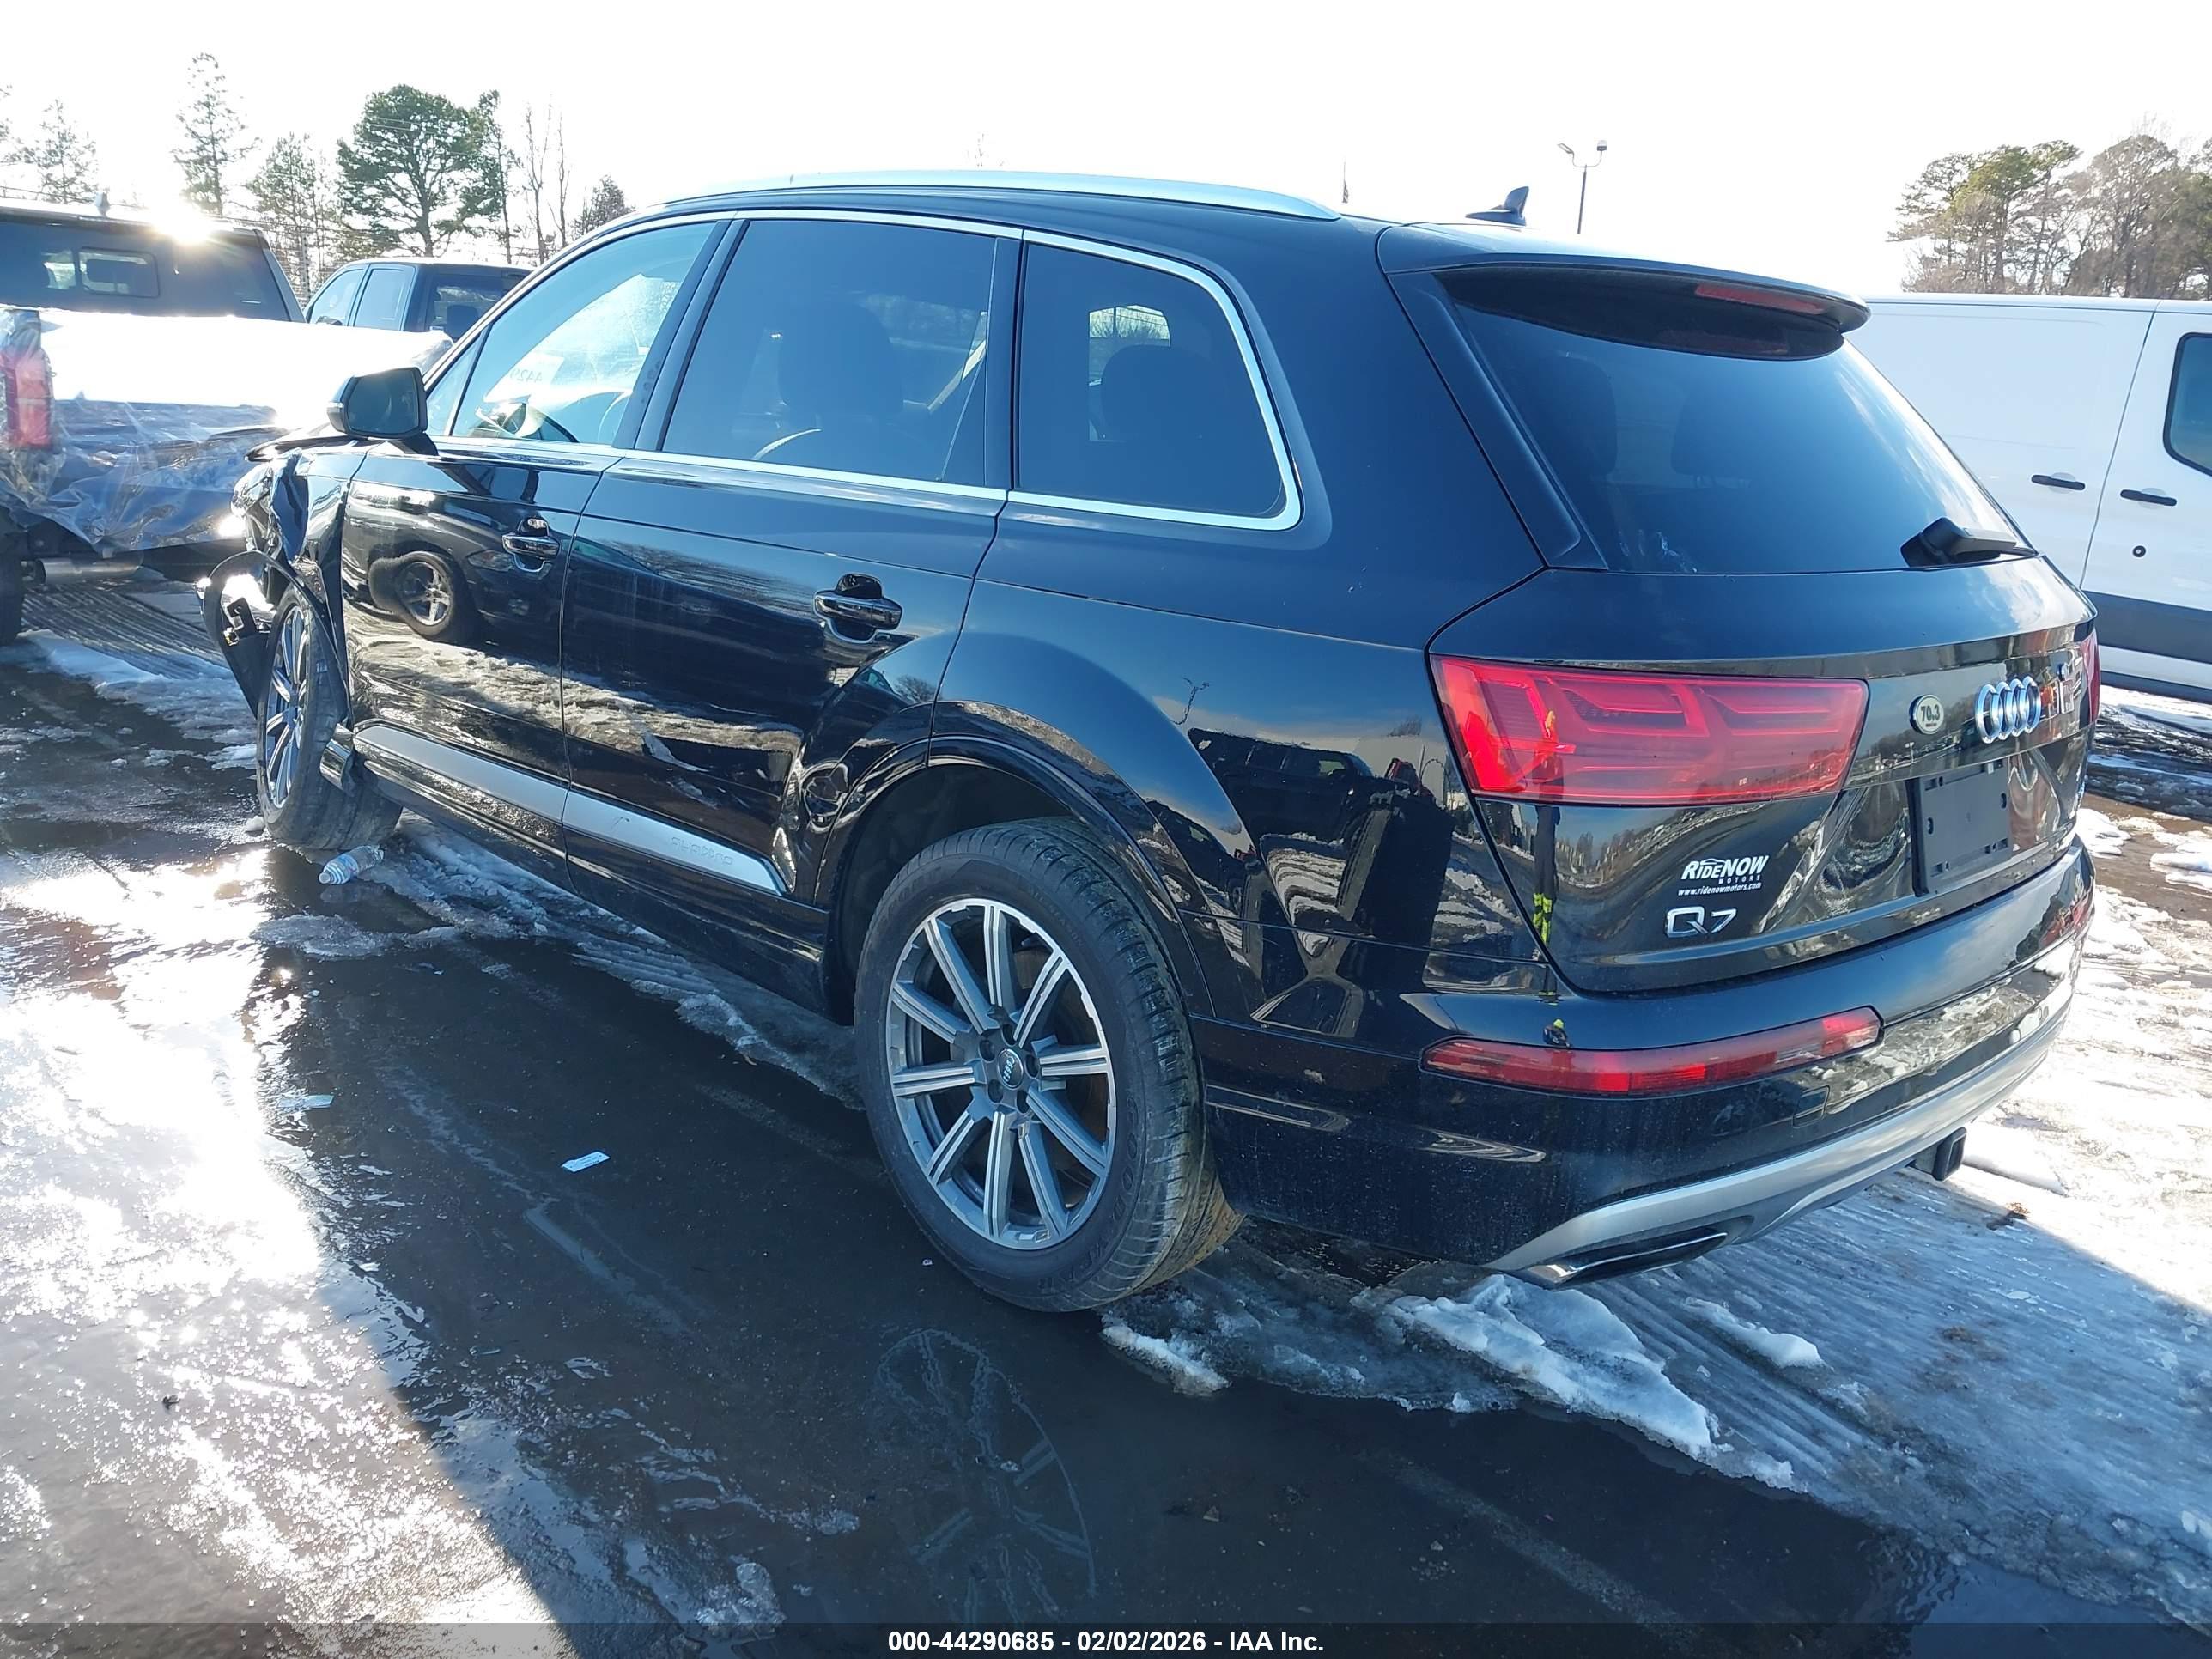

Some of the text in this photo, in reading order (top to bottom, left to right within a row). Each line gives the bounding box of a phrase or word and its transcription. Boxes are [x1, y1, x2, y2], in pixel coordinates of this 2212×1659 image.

[1920, 703, 1941, 722] 70.3
[1718, 874, 1760, 884] MOTORS
[1678, 882, 1761, 896] www.ridenowmotors.com
[1666, 906, 1736, 938] Q7
